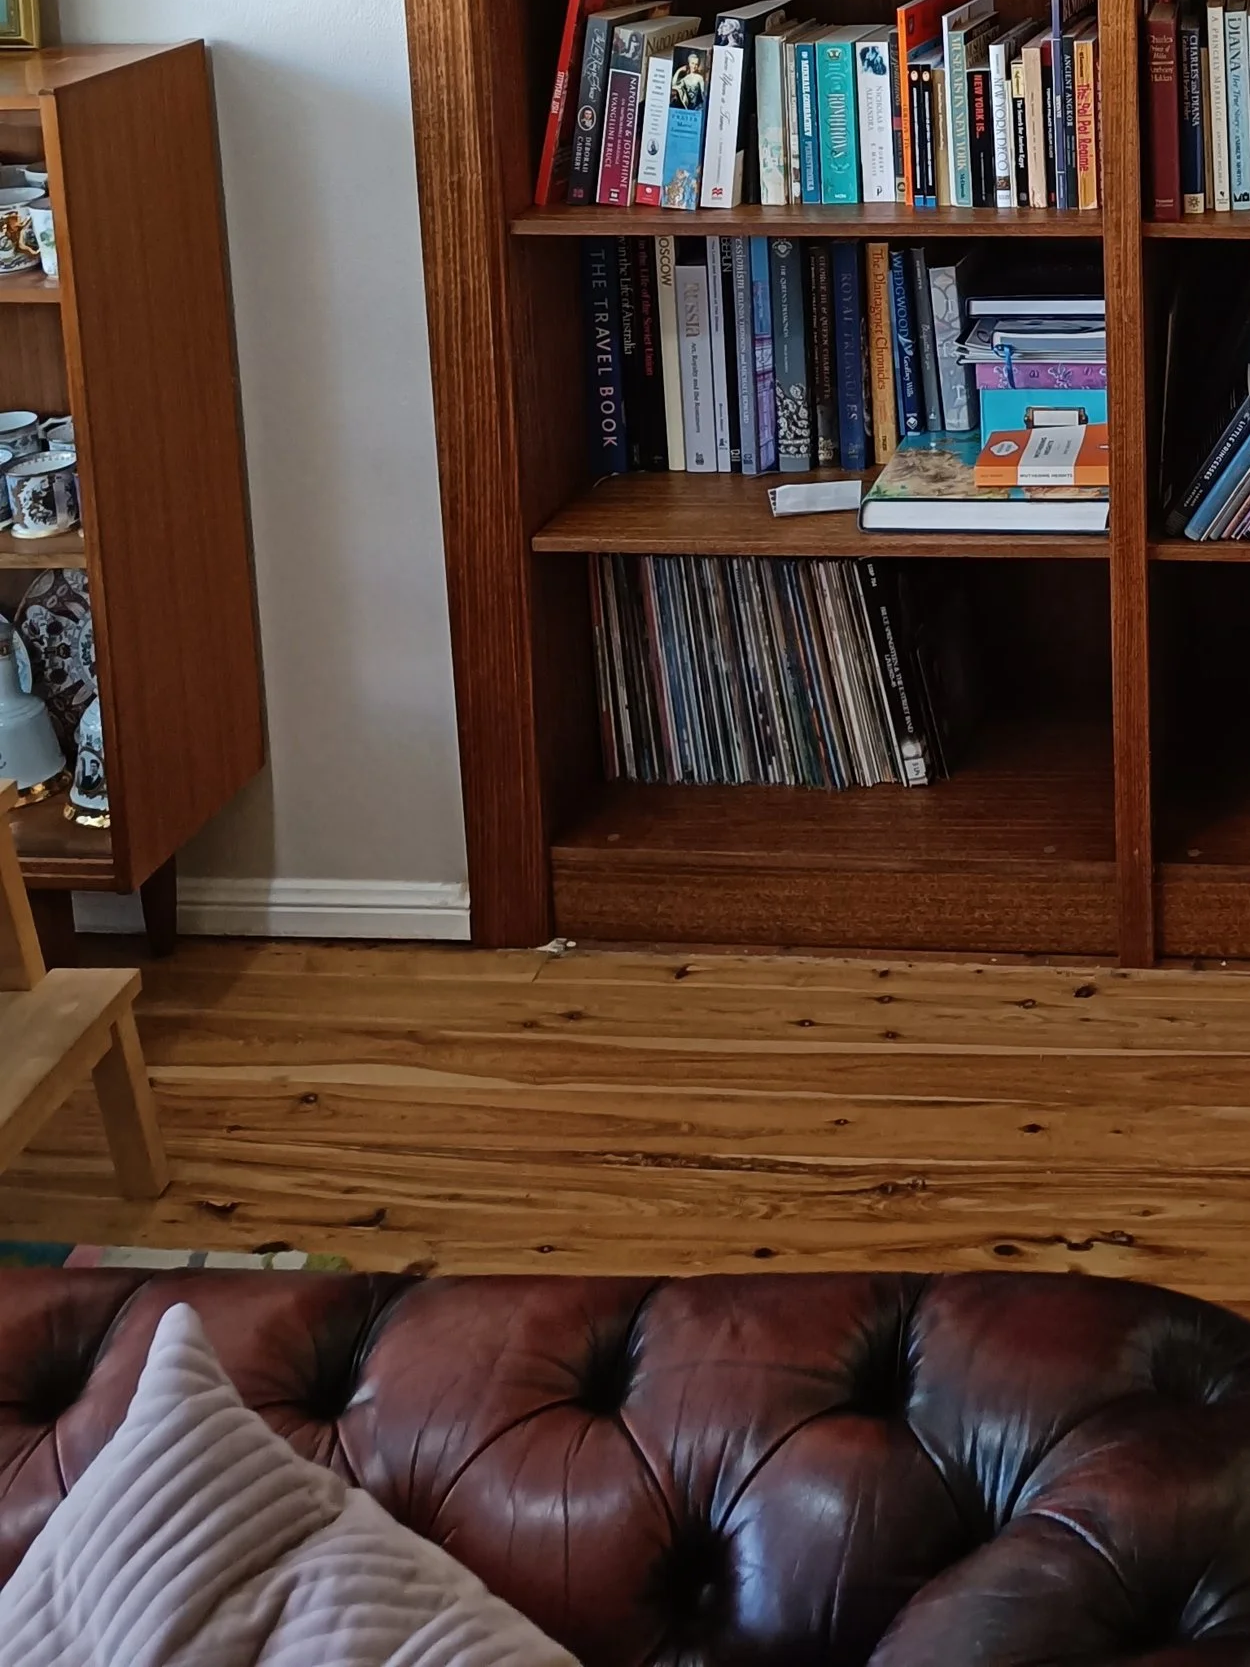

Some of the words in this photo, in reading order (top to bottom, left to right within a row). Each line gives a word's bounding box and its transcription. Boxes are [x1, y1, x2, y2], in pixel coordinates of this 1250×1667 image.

[1188, 34, 1198, 78] CHARLES
[973, 74, 982, 93] NEW
[993, 77, 1005, 99] NEW
[1076, 83, 1089, 99] The
[1190, 79, 1198, 94] and
[607, 91, 618, 140] EVANGELINE
[625, 77, 637, 127] NAPOLEON
[974, 96, 983, 120] YORK
[994, 100, 1007, 134] YORK
[1077, 102, 1090, 116] Pol
[1190, 95, 1199, 126] DIANA
[1078, 120, 1090, 134] Pot
[604, 143, 613, 168] BRUCE
[619, 139, 631, 188] JOSEPHINE
[996, 137, 1008, 171] DECO
[1078, 138, 1091, 171] Regime
[589, 249, 606, 289] THE
[870, 249, 883, 270] The
[682, 282, 701, 338] RUSSIA
[868, 273, 885, 336] Plantagenet
[592, 298, 612, 375] TRAVEL
[874, 339, 889, 390] Chronicles
[598, 385, 617, 448] BOOK
